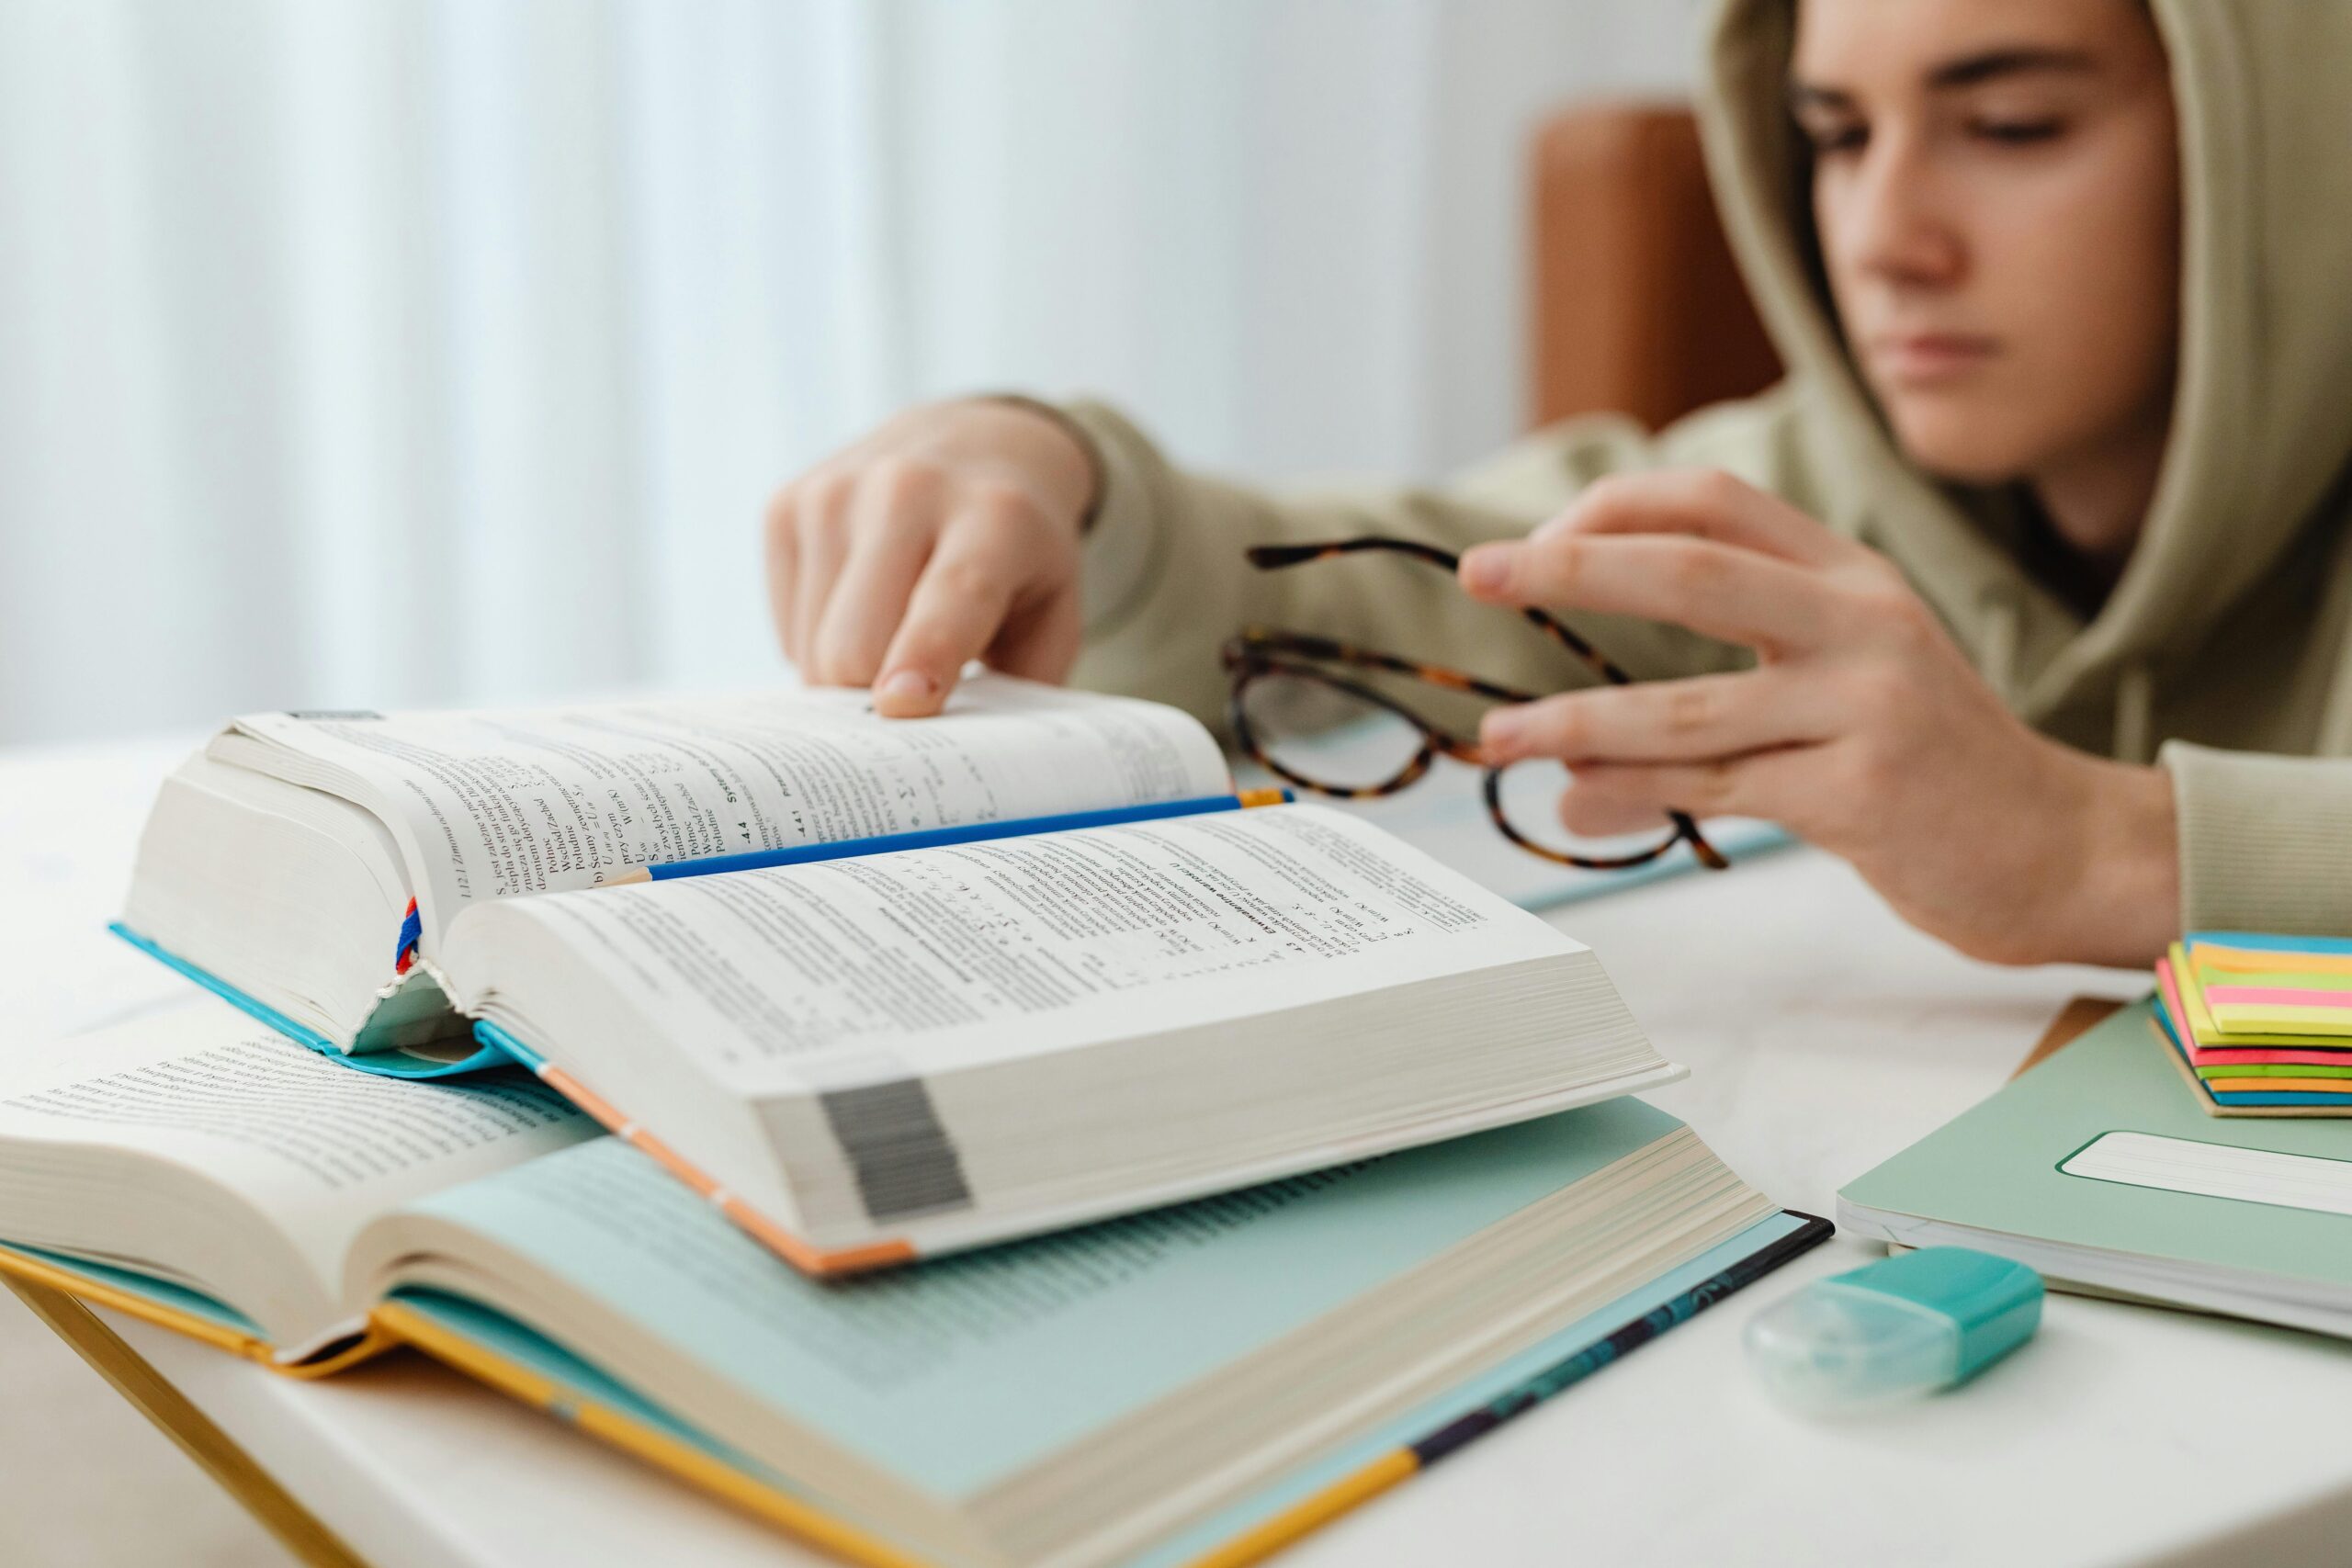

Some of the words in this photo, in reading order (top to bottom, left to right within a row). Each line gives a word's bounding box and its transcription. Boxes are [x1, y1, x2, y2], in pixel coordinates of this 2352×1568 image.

[448, 780, 477, 811] pierwszej
[466, 785, 480, 797] Dla
[634, 783, 650, 801] ścian
[644, 778, 673, 821] następujące
[710, 769, 737, 803] Systemy
[423, 797, 447, 825] ochrona
[478, 798, 496, 821] ciepła.
[489, 795, 509, 821] funkcją
[503, 794, 534, 841] dotyczącym
[559, 788, 589, 831] zewnętrzne
[676, 784, 712, 854] Wschód/Zachód
[478, 822, 497, 856] zależne
[491, 823, 506, 843] strat
[507, 824, 520, 835] go
[534, 799, 571, 872] Wschód/Zachód
[607, 813, 623, 838] czym
[647, 804, 671, 850] zwykłych
[684, 821, 700, 855] Północ
[706, 809, 725, 852] Południe
[443, 827, 463, 864] Zimowa
[501, 845, 512, 858] do
[512, 838, 524, 852] się
[543, 838, 559, 874] Północ
[565, 826, 585, 870] Południe
[585, 834, 600, 869] Ściany
[619, 841, 633, 864] przy
[492, 860, 505, 878] jest
[505, 855, 519, 894] ciepła
[518, 854, 533, 891] znacza
[529, 844, 546, 890] dzeniem
[594, 871, 604, 883] b)
[1064, 865, 1107, 893] przenikania
[1076, 862, 1126, 895] przejmowania
[1102, 869, 1134, 889] absorpcji
[1119, 859, 1166, 889] współczynnik
[1180, 869, 1216, 893] wartości
[1208, 865, 1247, 891] przypadku
[456, 869, 471, 897] 1.12.1
[992, 871, 1039, 902] zmniejszający
[1017, 866, 1064, 897] zmniejszający
[1054, 880, 1089, 905] całkowity
[1060, 873, 1093, 896] elementu
[1154, 873, 1193, 898] temperatur
[1275, 871, 1324, 903] współczynnik
[1028, 884, 1090, 929] przeciwsłoneczną
[1062, 898, 1110, 934] współczynnik
[1091, 897, 1141, 930] powierzchnia
[1103, 893, 1151, 928] współczynnik
[1122, 896, 1150, 913] cieplny
[1132, 890, 1179, 923] współczynnik
[1144, 887, 1193, 921] współczynnik
[1167, 891, 1207, 919] zewnętrzny
[1193, 898, 1220, 917] różnica
[1216, 893, 1276, 933] Ekwiwalentne
[1238, 897, 1268, 916] wartość
[1264, 906, 1283, 917] strat
[1090, 908, 1125, 931] skuteczny
[1148, 914, 1167, 926] opór
[1268, 917, 1311, 942] przypadku
[1282, 917, 1311, 934] samych
[1334, 919, 1357, 931] czym
[1307, 942, 1325, 952] tym
[1310, 934, 1335, 949] takich
[1330, 936, 1351, 948] okna
[1358, 932, 1378, 942] przy
